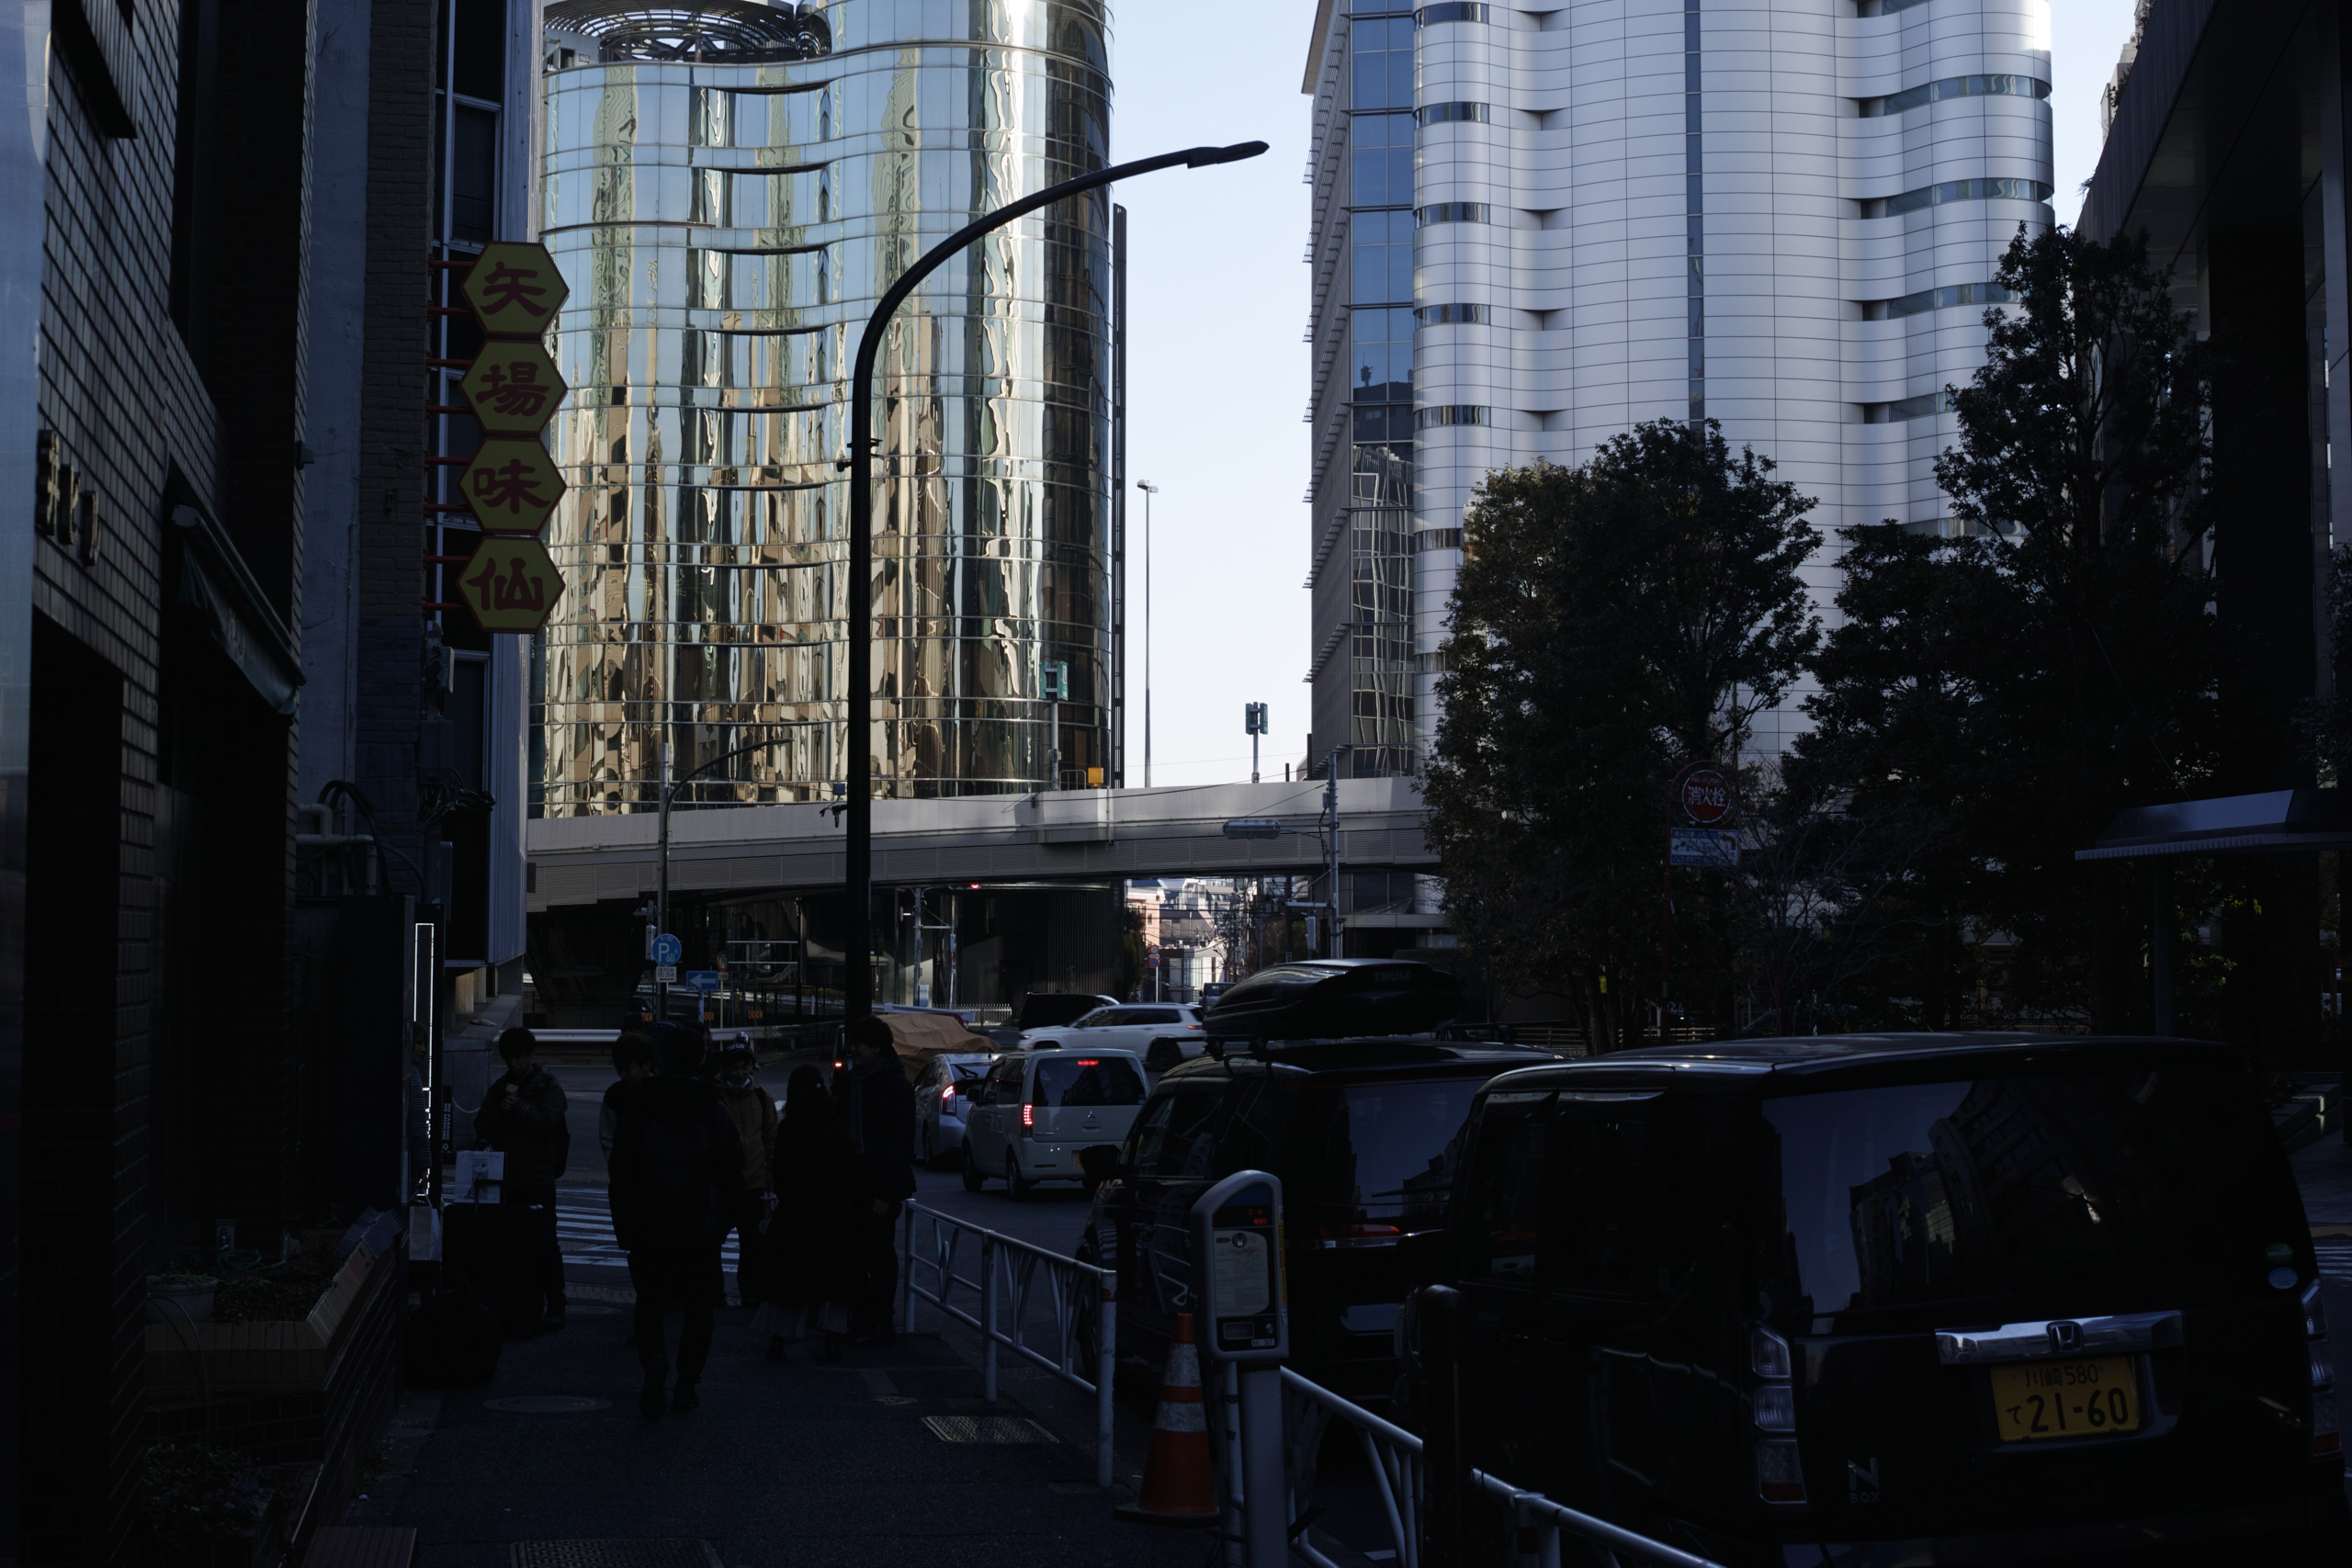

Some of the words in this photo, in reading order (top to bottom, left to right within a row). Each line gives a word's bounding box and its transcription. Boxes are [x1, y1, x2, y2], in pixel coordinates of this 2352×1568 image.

[466, 260, 551, 613] 矢場味仙
[1688, 785, 1726, 807] 消火栓
[658, 942, 670, 963] P
[666, 953, 675, 963] 60
[1374, 970, 1411, 982] THULE
[2006, 1404, 2021, 1425] て
[2027, 1387, 2129, 1433] 21-60
[1847, 1458, 1880, 1491] N
[1849, 1492, 1881, 1504] BOX
